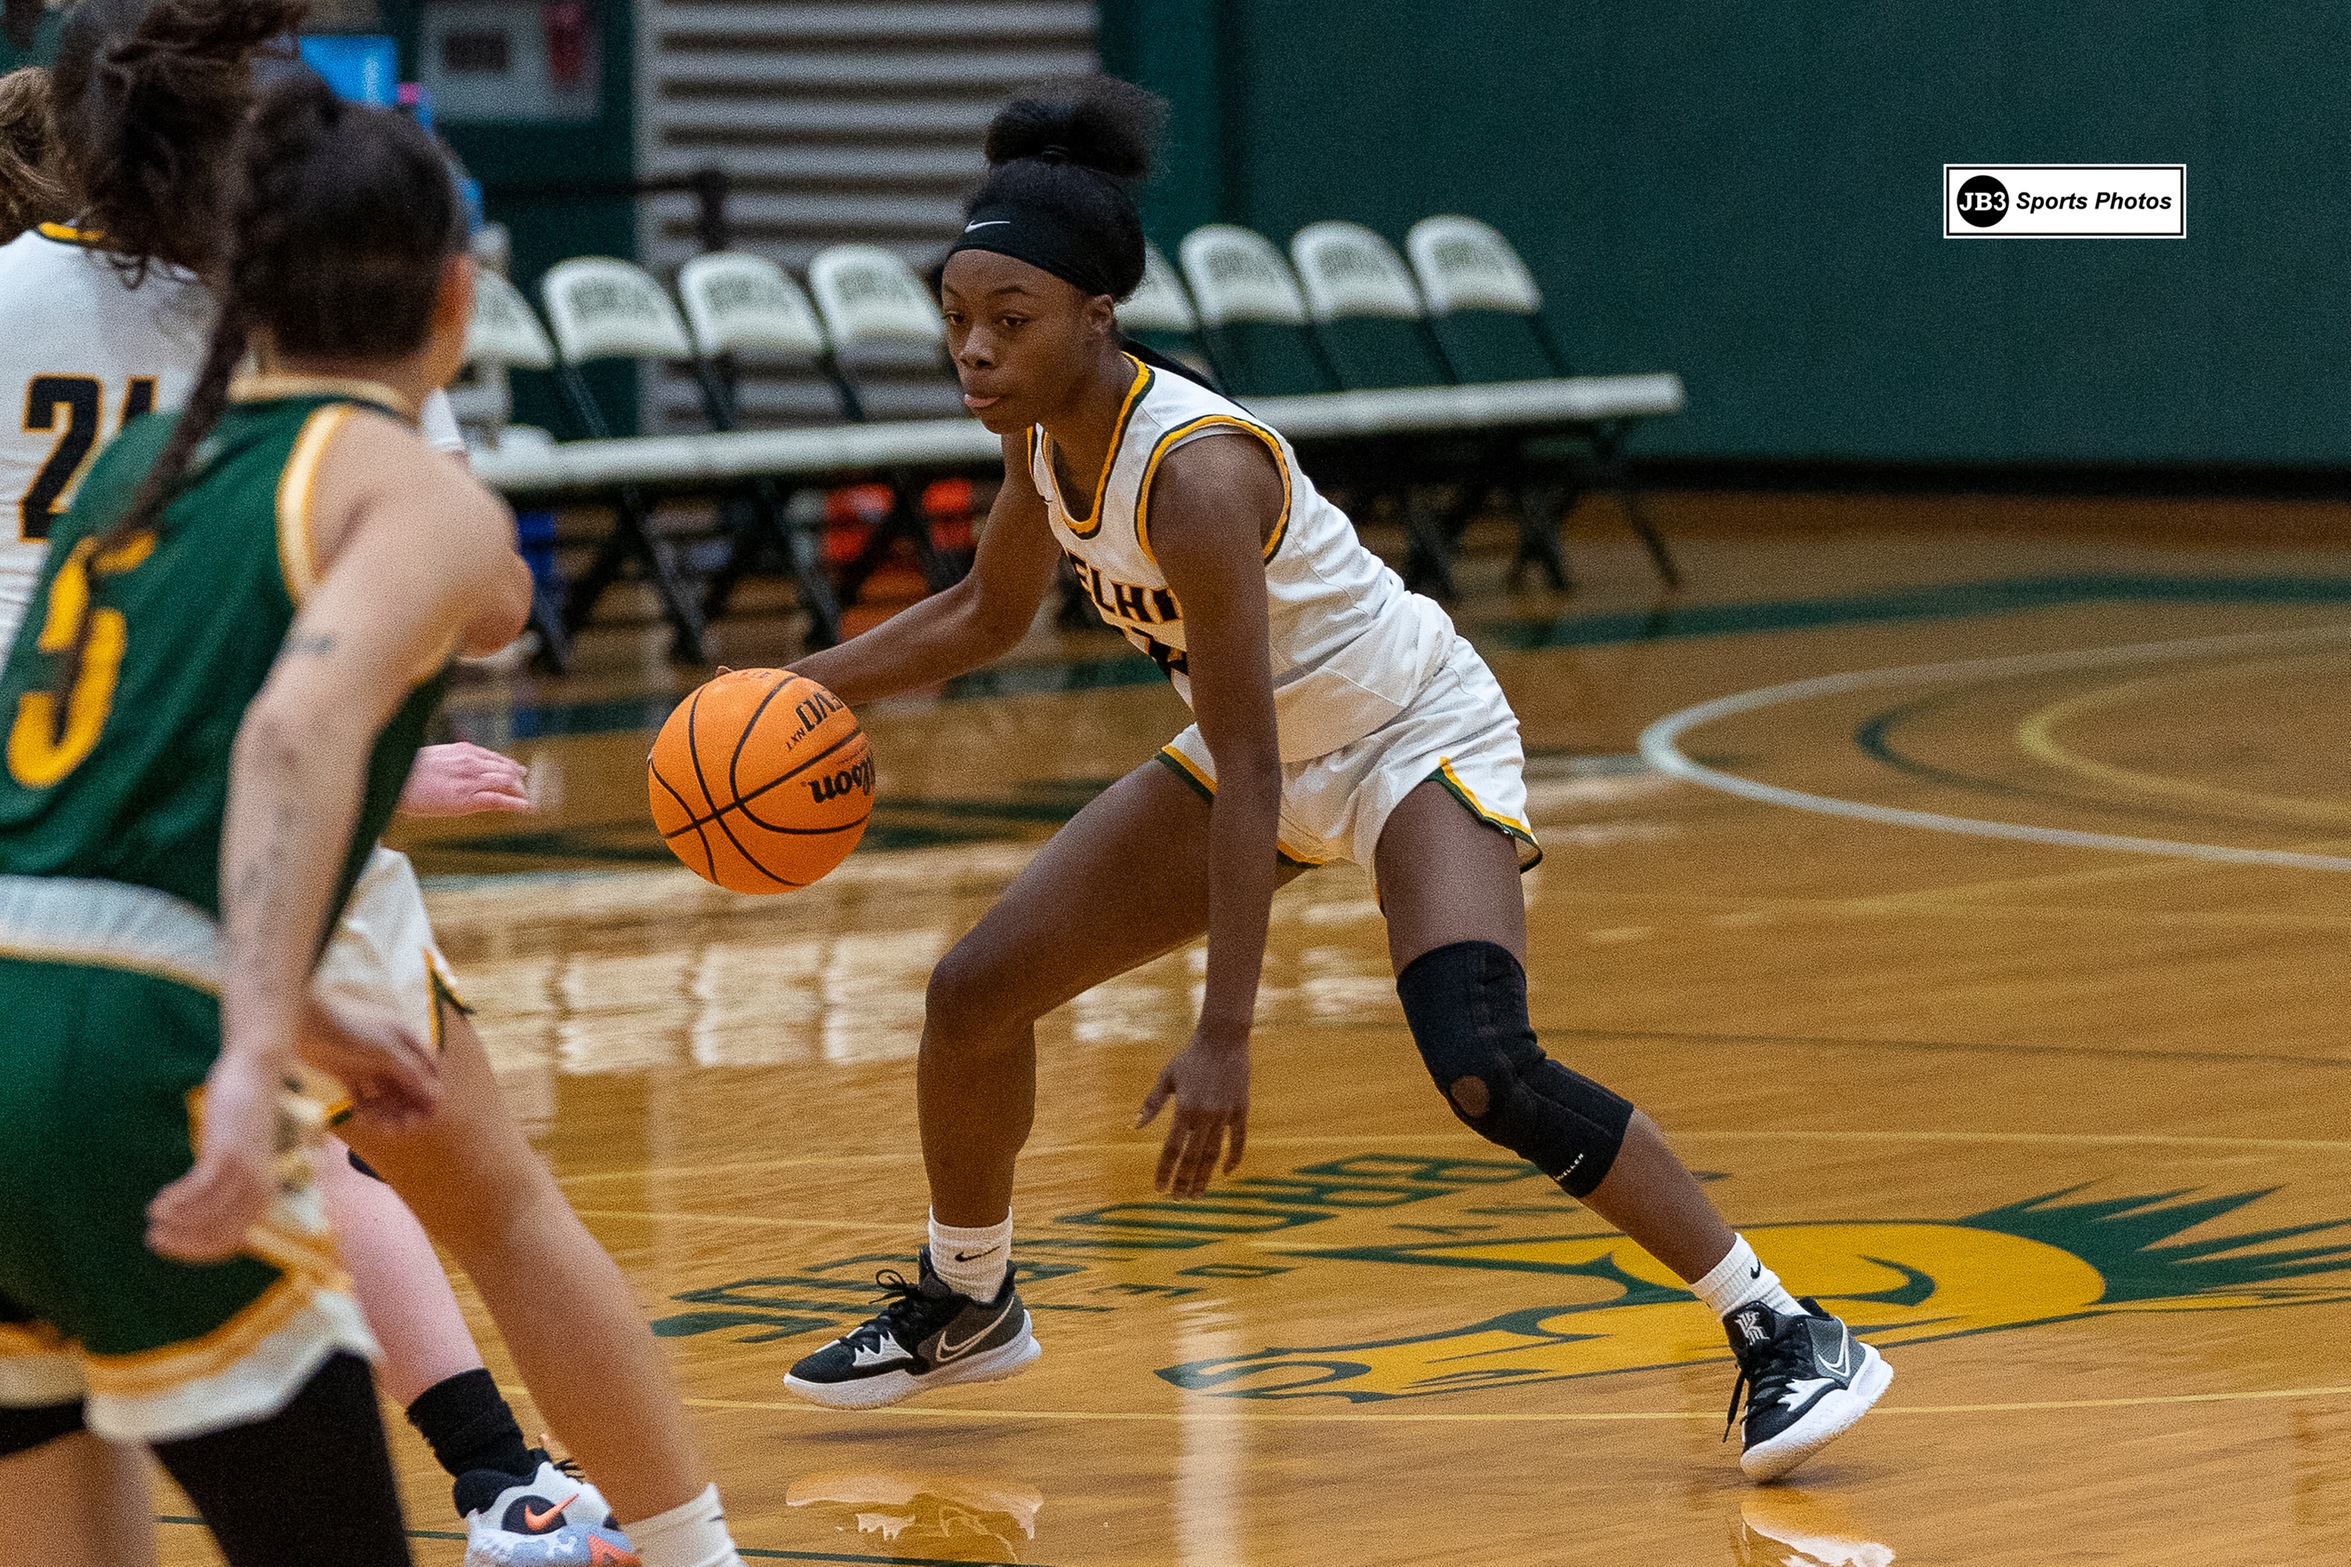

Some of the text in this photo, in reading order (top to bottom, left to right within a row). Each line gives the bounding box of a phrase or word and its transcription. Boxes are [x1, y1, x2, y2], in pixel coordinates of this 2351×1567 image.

[18, 374, 158, 543] 2
[1063, 548, 1184, 624] ELHI
[807, 755, 876, 803] ilson
